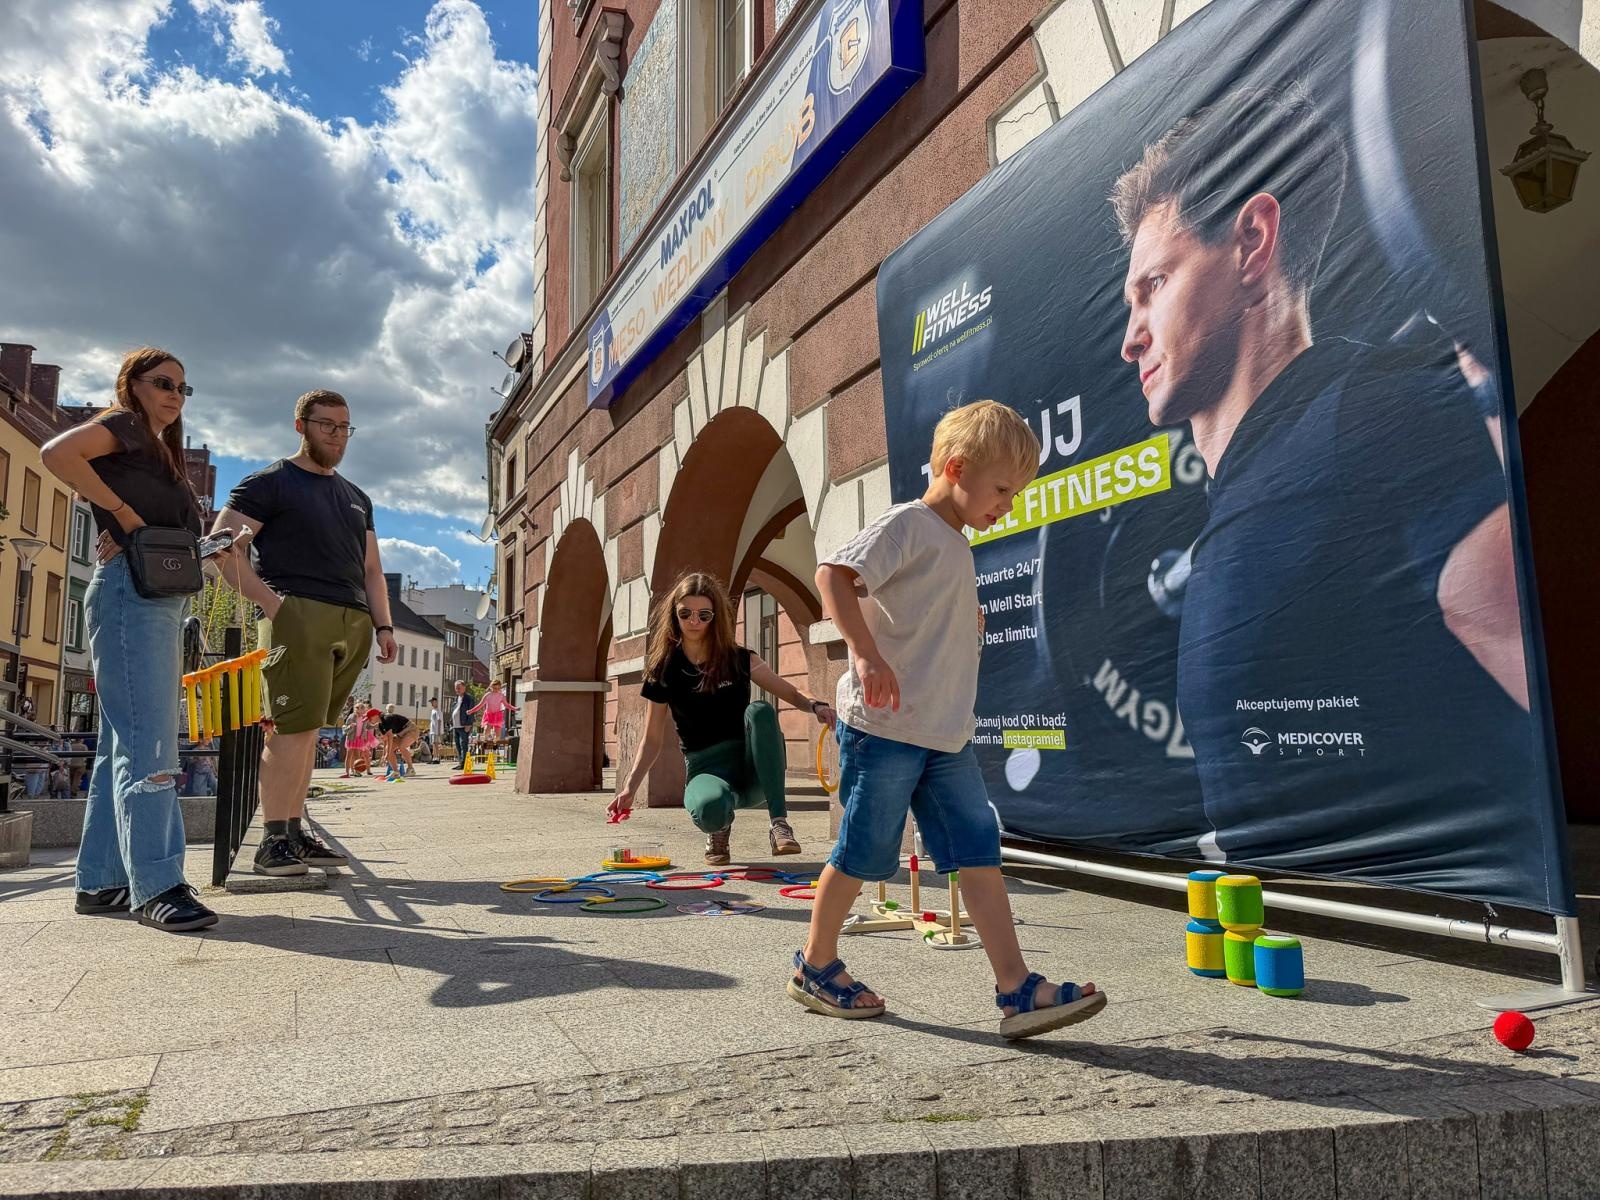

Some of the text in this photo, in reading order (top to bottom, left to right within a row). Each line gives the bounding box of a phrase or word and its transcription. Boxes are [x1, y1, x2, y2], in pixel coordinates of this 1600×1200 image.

[660, 178, 715, 269] MAXPOL
[926, 281, 971, 326] WELL
[922, 285, 993, 349] FITNESS
[949, 340, 957, 349] na
[956, 315, 993, 345] wellfitness.pl
[1025, 446, 1162, 522] FITNESS
[976, 558, 1041, 587] otwarte 24/7
[989, 596, 1013, 614] Well
[1014, 591, 1043, 609] Start
[985, 625, 1038, 645] bez limitu
[1236, 695, 1360, 712] Akceptujemy pakiet
[975, 712, 1067, 730] skanuj kod QR i bądź
[971, 732, 1063, 748] nami na Instagramie!
[1277, 732, 1364, 745] MEDICOVER
[1279, 748, 1366, 757] SPORT
